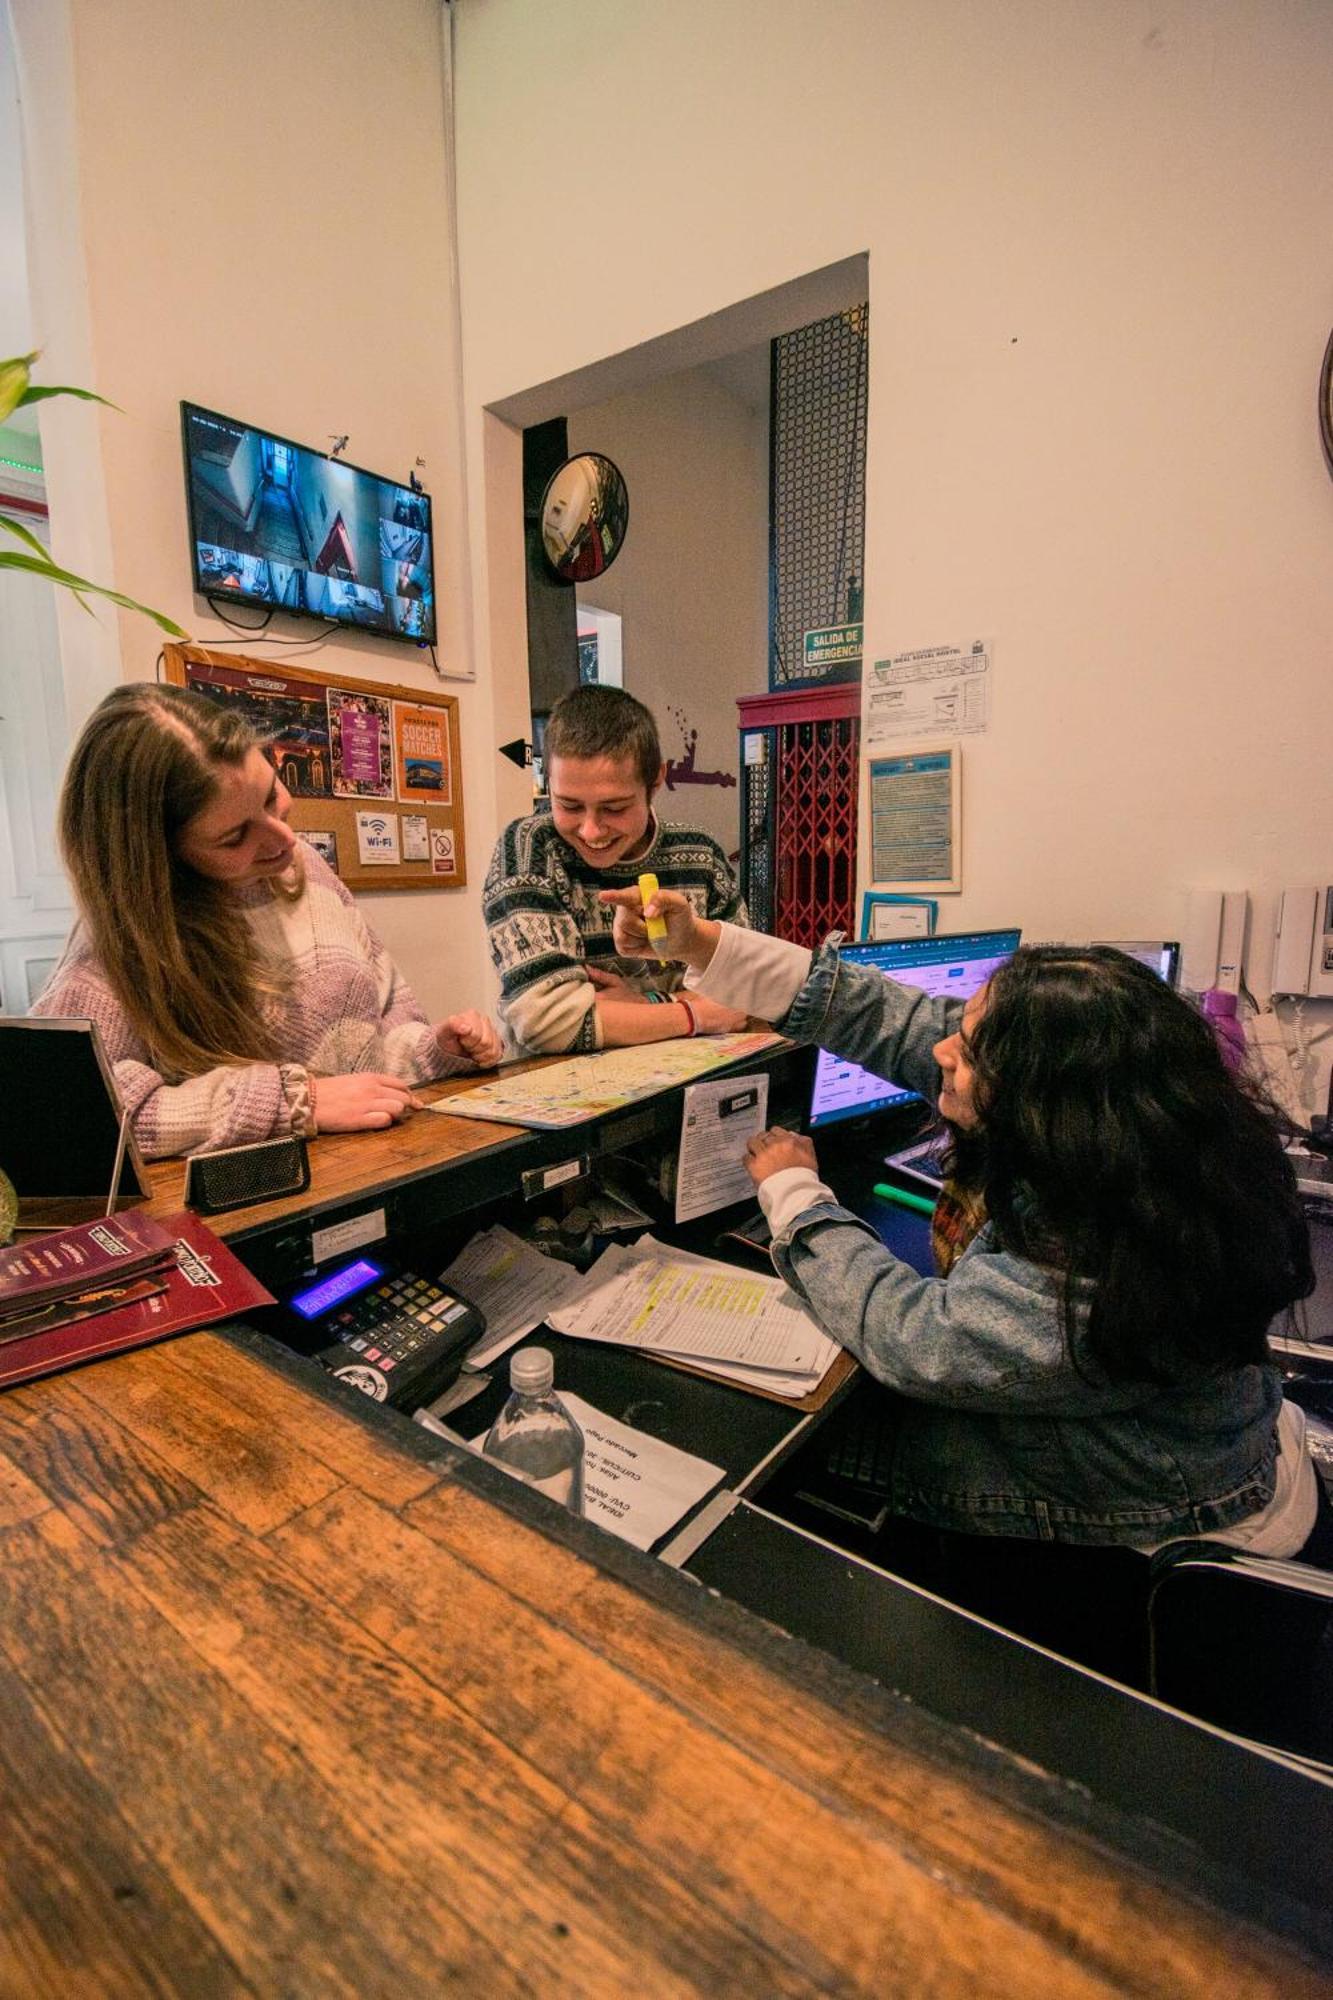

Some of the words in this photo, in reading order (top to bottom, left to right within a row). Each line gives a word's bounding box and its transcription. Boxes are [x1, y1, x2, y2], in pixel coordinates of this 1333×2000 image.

[813, 633, 844, 647] SALIDA
[846, 630, 858, 642] DE
[402, 724, 441, 743] SOCCER
[367, 837, 392, 847] Wi-Fi
